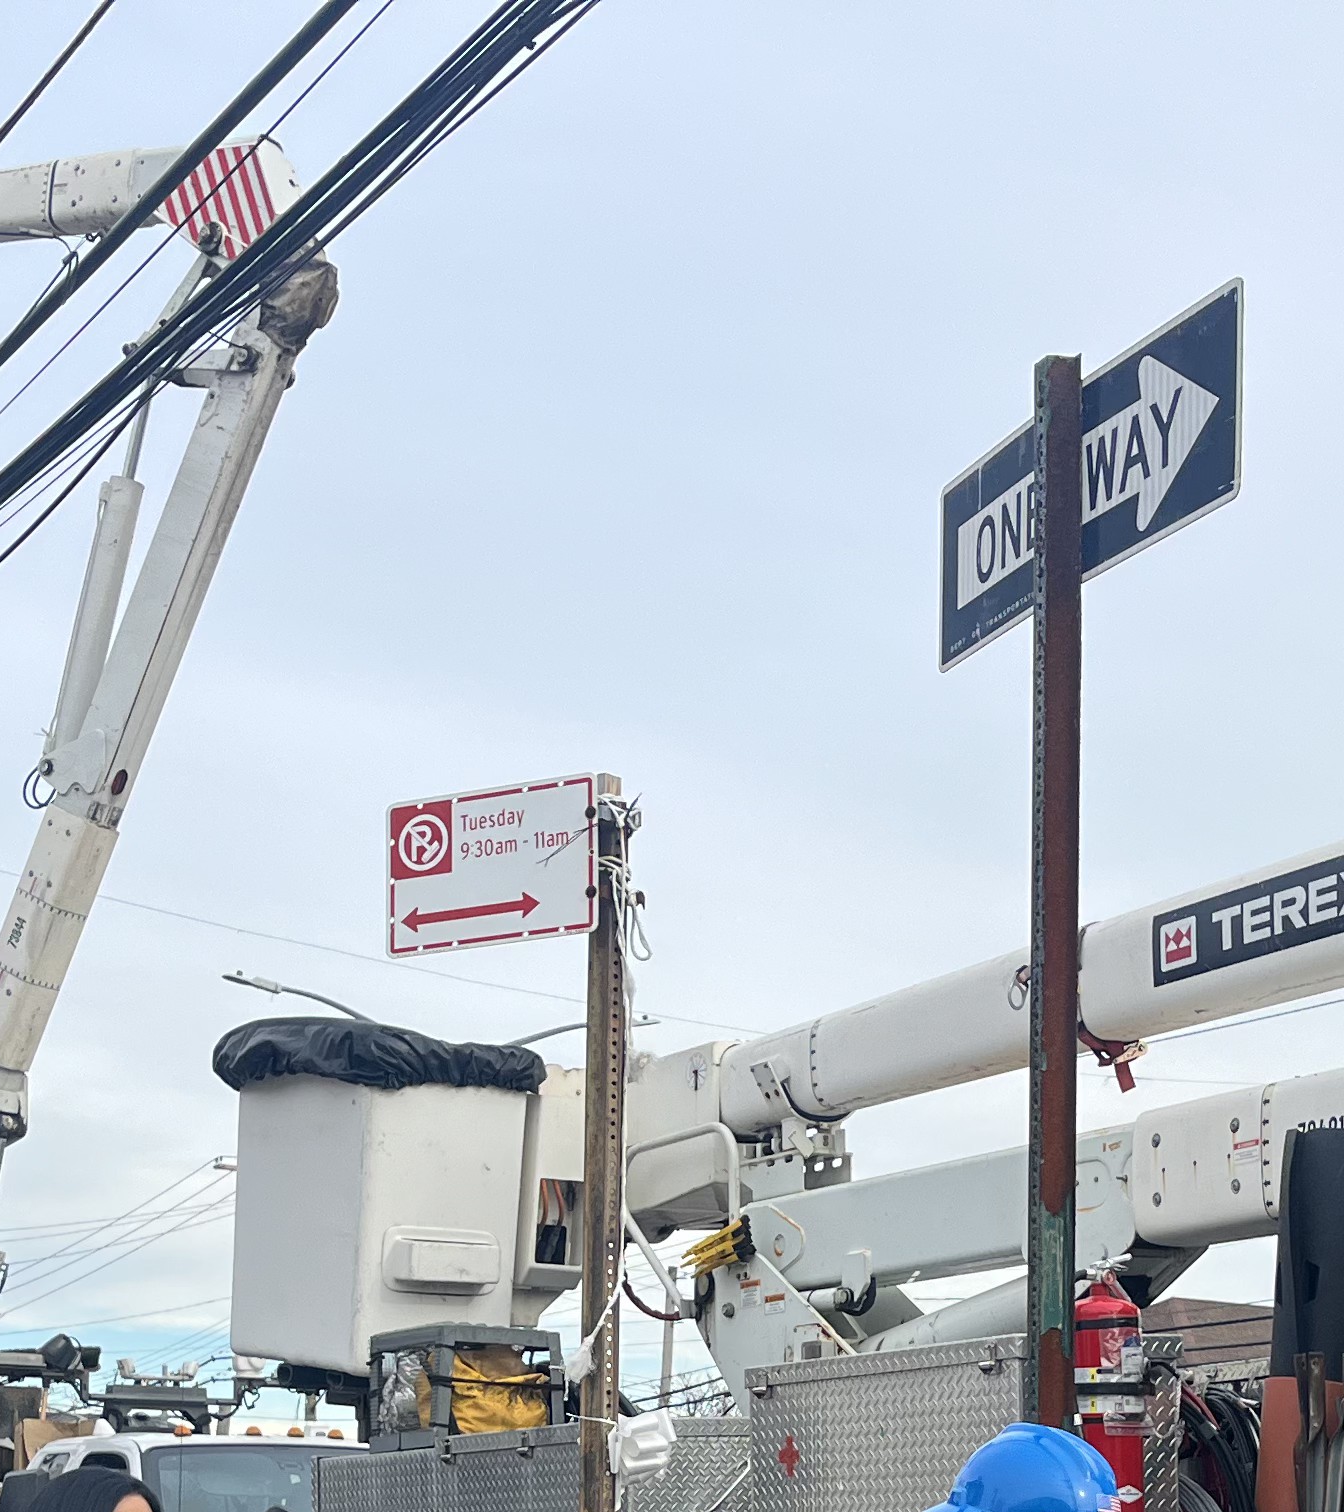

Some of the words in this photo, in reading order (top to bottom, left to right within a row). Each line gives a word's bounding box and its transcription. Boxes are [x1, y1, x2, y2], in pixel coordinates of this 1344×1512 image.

[976, 481, 1035, 584] ONE
[1086, 385, 1184, 512] WAY
[460, 808, 525, 832] Tuesday
[460, 839, 518, 860] 9:30am
[533, 830, 570, 849] 11am
[6, 916, 27, 949] 73844
